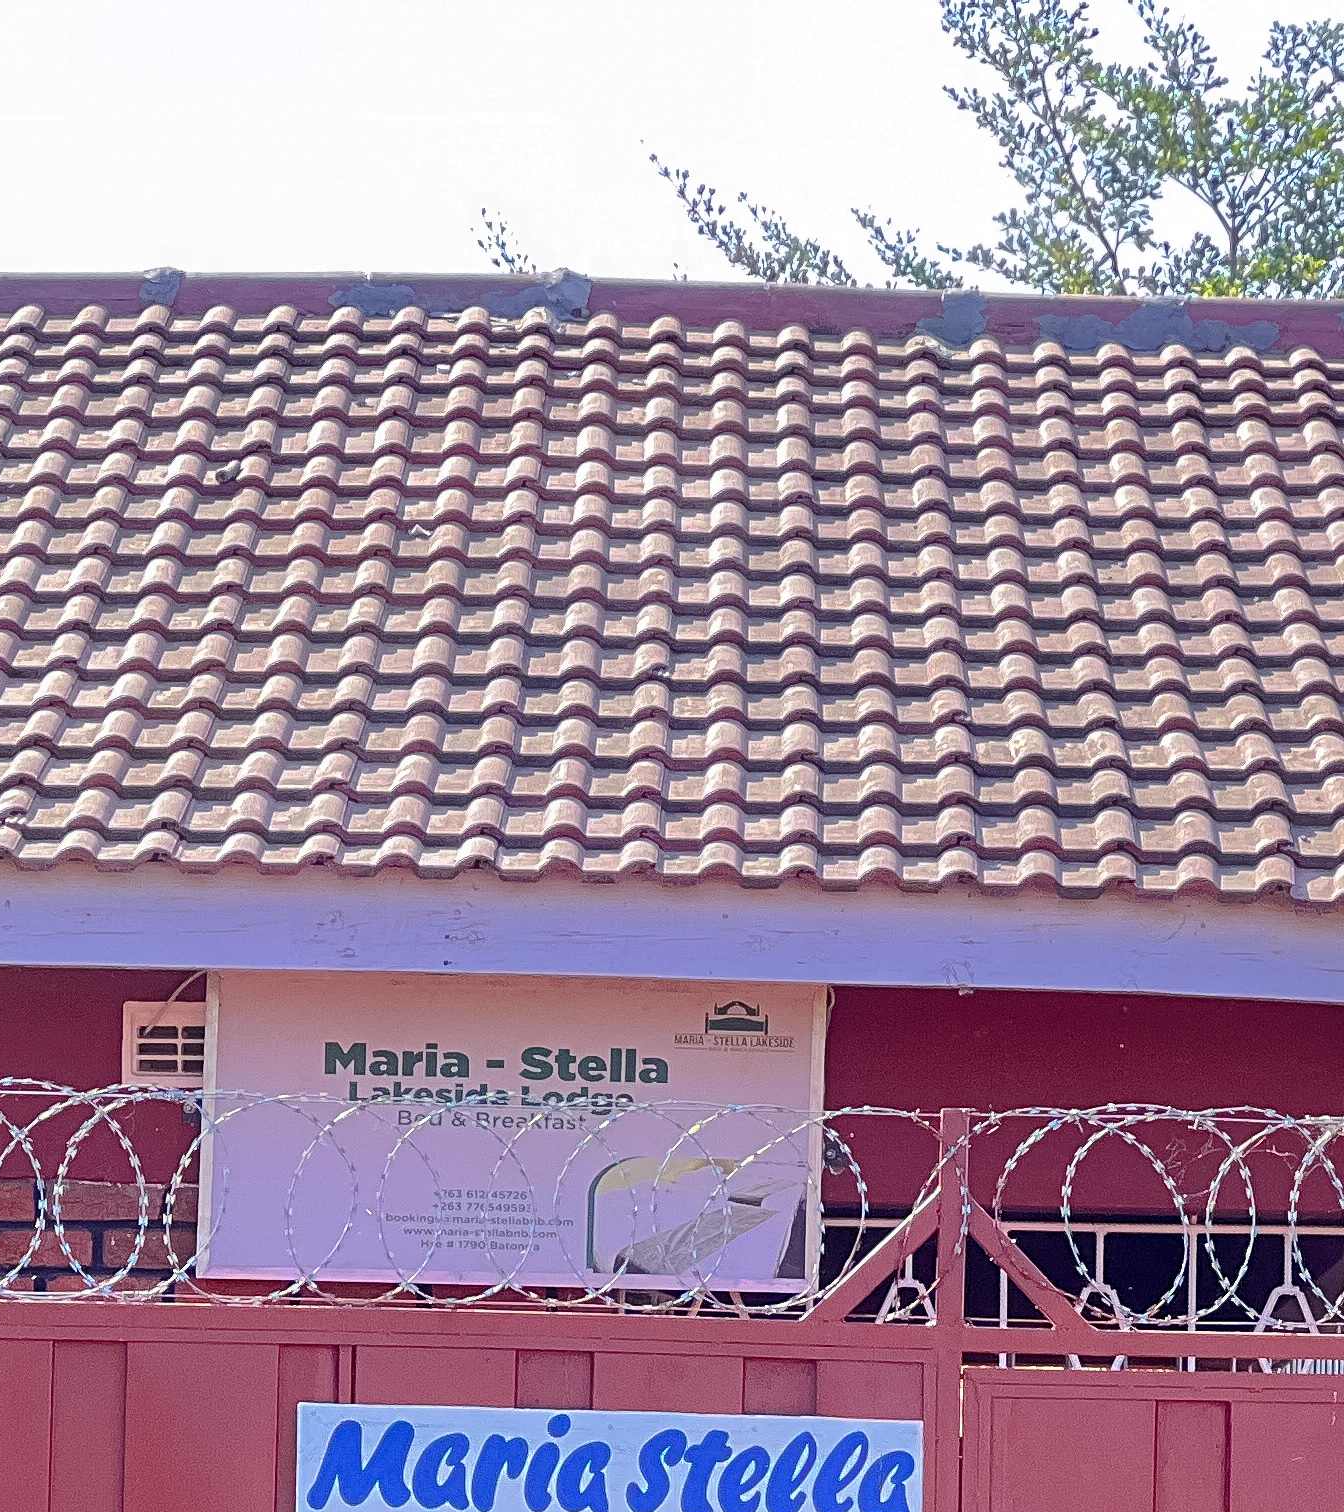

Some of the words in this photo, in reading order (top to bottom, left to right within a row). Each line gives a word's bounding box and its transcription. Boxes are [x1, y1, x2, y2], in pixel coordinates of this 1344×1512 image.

[674, 1034, 704, 1046] MARIA
[713, 1035, 748, 1048] STELLA
[750, 1036, 794, 1049] LAKESIDE
[324, 1042, 470, 1079] Maria
[486, 1059, 505, 1069] -
[519, 1047, 669, 1084] Stella
[349, 1081, 509, 1106] Lakeside
[521, 1086, 635, 1115] Lodge
[451, 1111, 466, 1127] &
[476, 1112, 586, 1131] Breakfast
